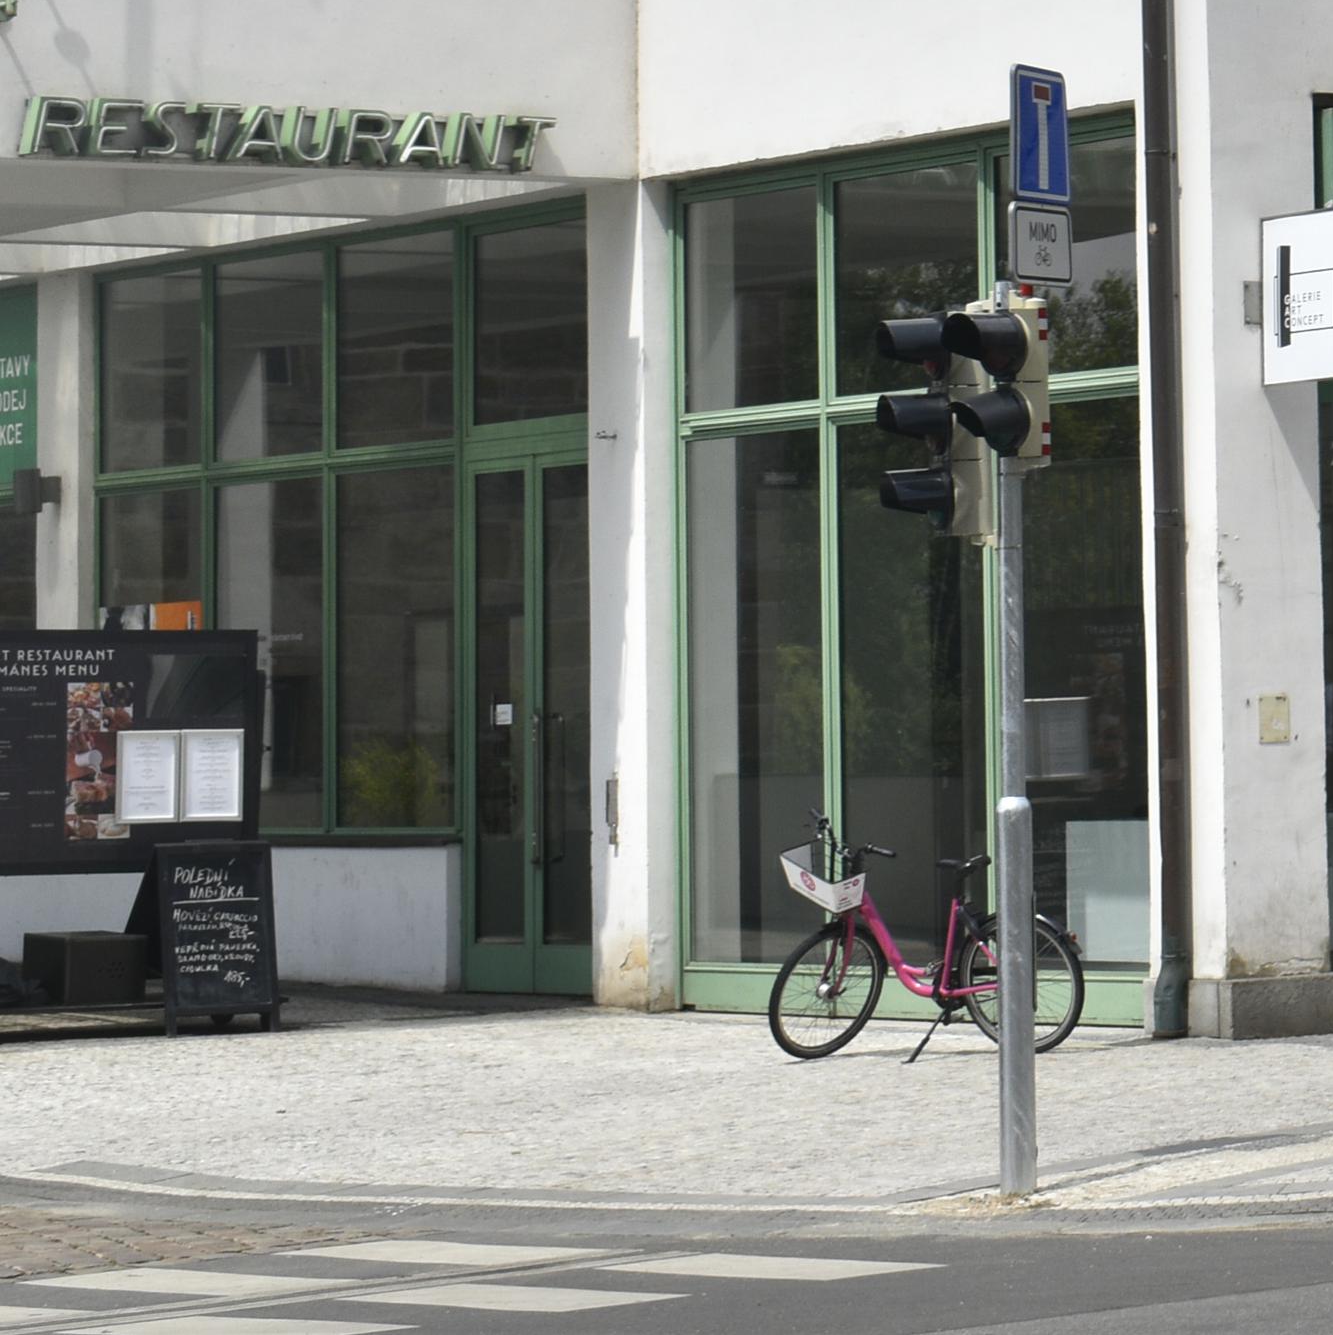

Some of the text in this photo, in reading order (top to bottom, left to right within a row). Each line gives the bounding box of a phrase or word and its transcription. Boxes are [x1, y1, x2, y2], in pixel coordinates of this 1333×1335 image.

[18, 96, 558, 174] RESTAURANT
[1028, 221, 1057, 243] MIMO
[1284, 290, 1322, 306] GALERIE
[1284, 304, 1302, 318] ART
[1284, 313, 1325, 329] CONCEPT
[17, 649, 115, 661] RESTAURANT
[0, 663, 100, 676] MÁNES MENU
